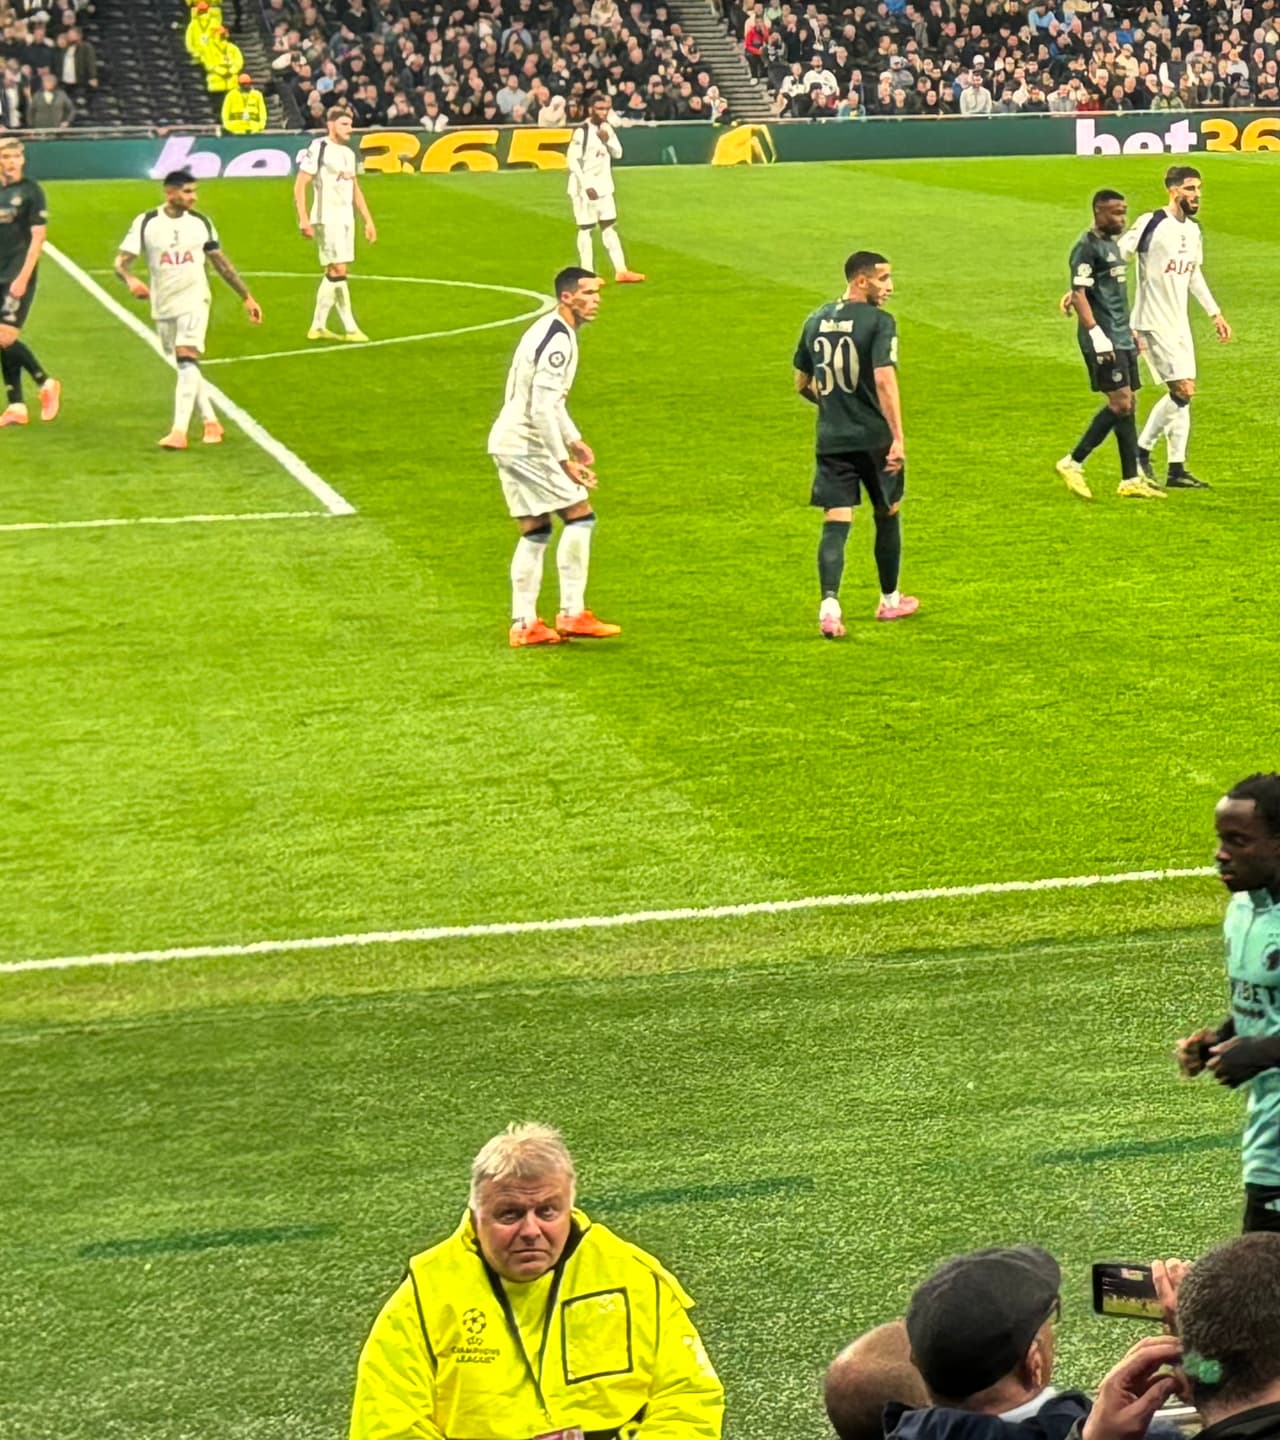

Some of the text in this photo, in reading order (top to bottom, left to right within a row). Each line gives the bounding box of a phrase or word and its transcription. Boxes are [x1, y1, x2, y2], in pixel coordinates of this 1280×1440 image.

[150, 127, 573, 179] be365
[159, 250, 195, 266] AIA
[814, 336, 860, 396] 30
